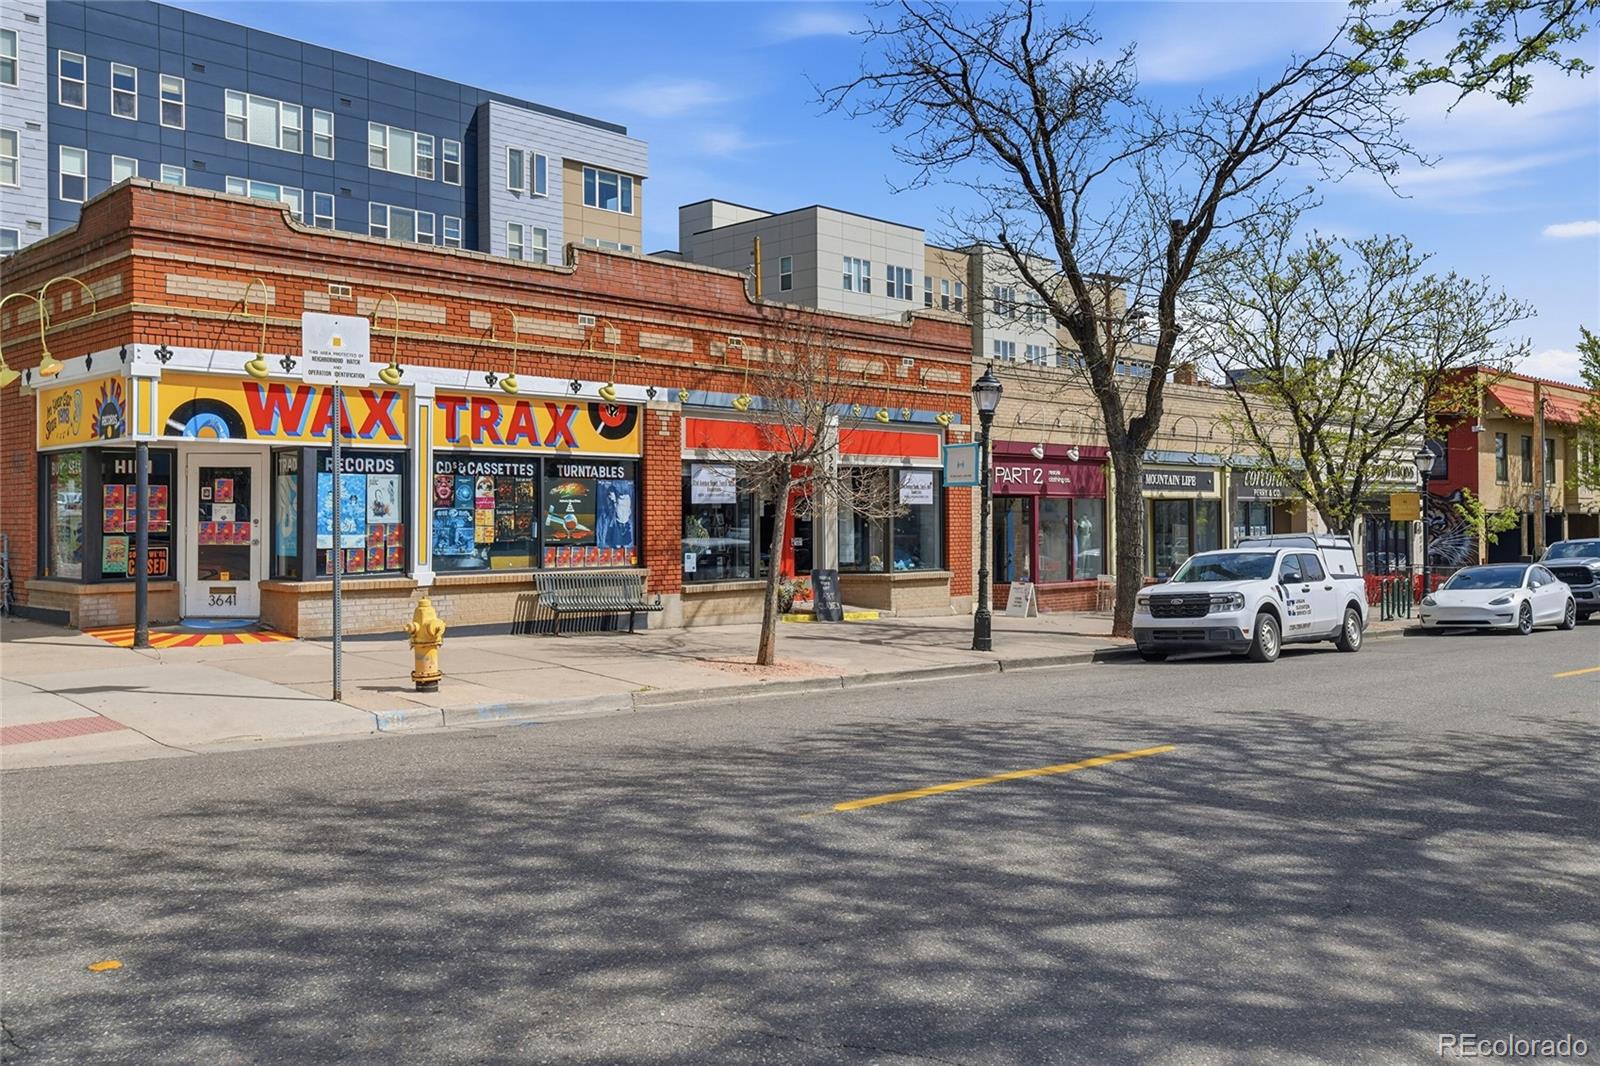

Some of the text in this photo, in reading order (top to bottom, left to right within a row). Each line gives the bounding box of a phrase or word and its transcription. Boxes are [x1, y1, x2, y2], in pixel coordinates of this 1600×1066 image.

[311, 356, 344, 364] NEIGHBORHOOD
[334, 371, 366, 379] IDENTIFICATION
[242, 381, 402, 441] WAX
[436, 395, 579, 449] TRAX
[467, 462, 534, 477] CASSETTES
[556, 464, 625, 479] TURNTABLES
[994, 466, 1043, 485] PART 2
[1145, 474, 1197, 487] MOUNTAIN LIFE
[1253, 488, 1268, 497] PERRY
[128, 558, 167, 575] CSED
[208, 594, 237, 607] 3641
